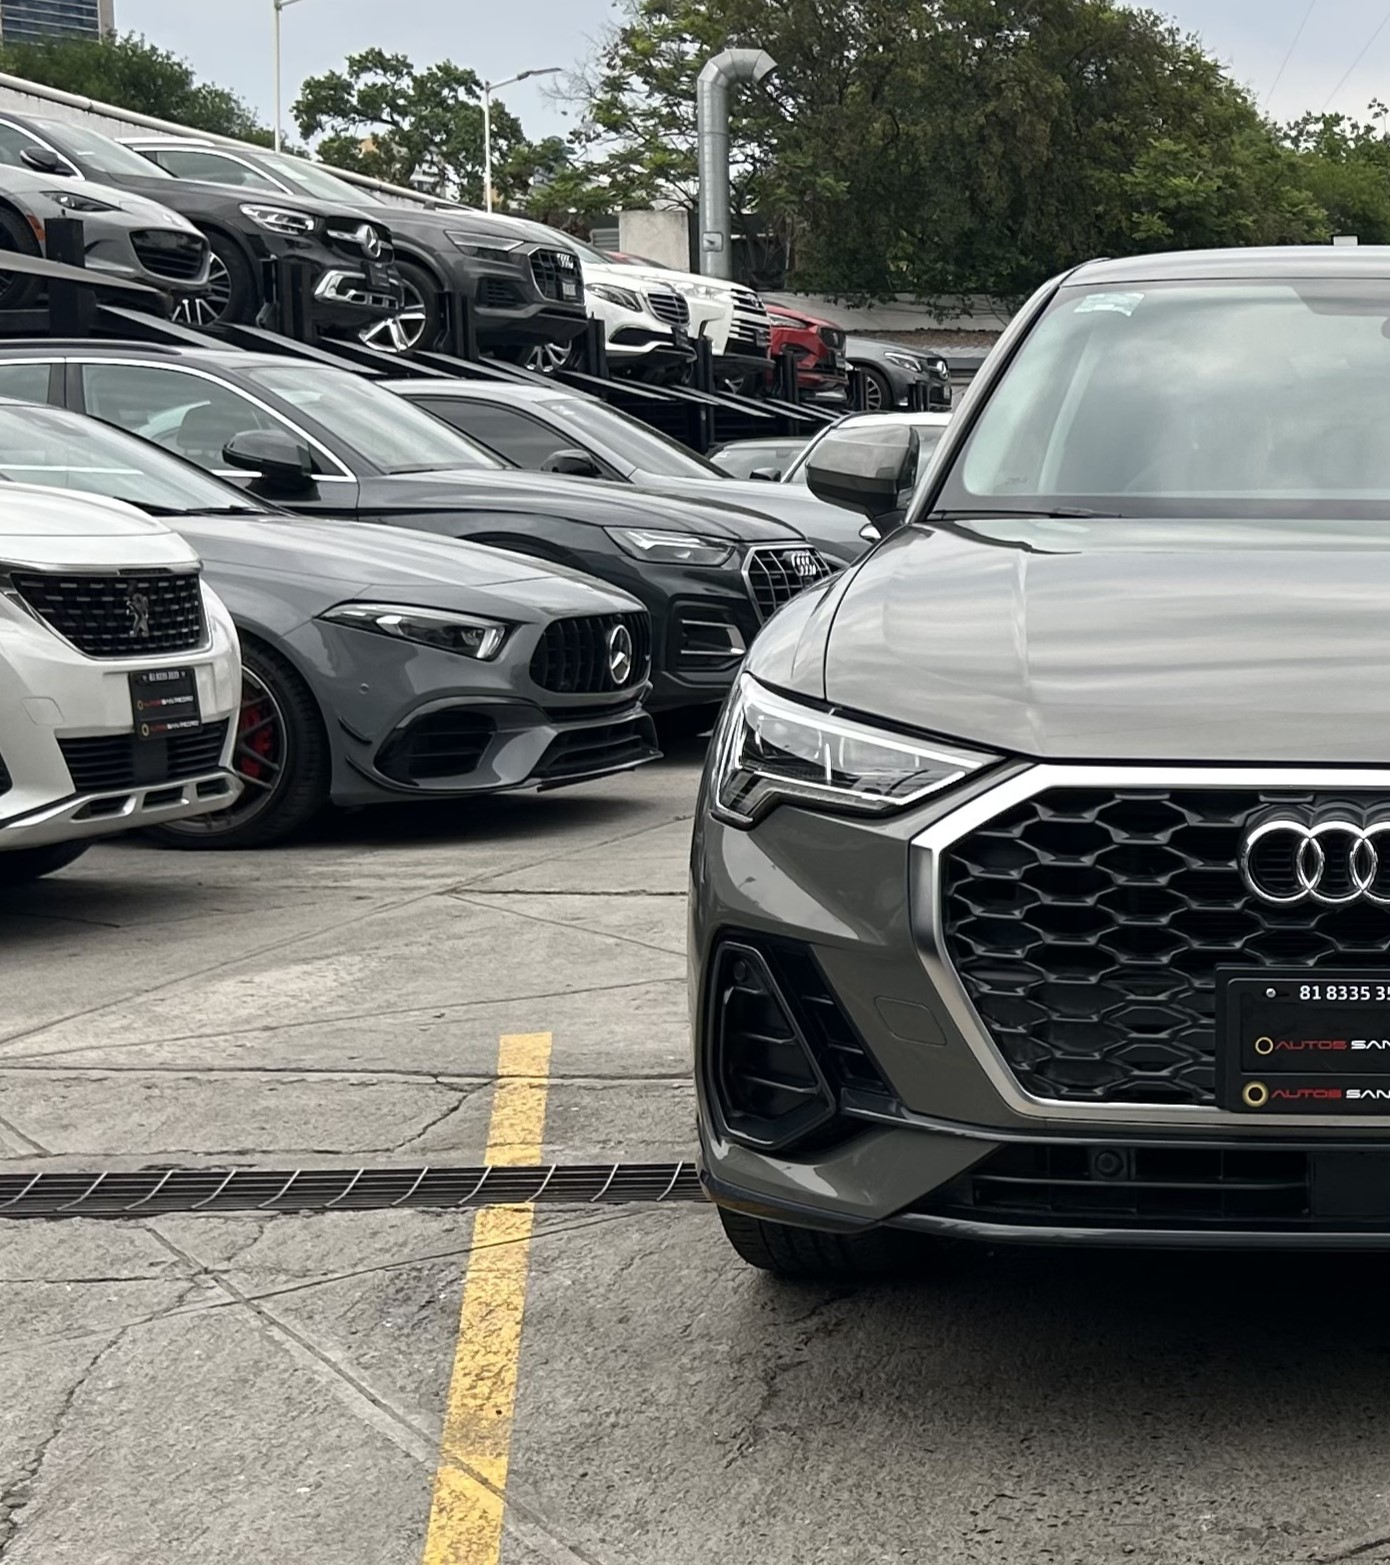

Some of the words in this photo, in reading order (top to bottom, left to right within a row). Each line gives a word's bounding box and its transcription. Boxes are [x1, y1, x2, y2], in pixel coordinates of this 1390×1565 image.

[1299, 985, 1321, 1001] 81
[1326, 985, 1371, 1001] 8335
[1275, 1040, 1348, 1050] AUTOS
[1271, 1088, 1342, 1098] AUTOS
